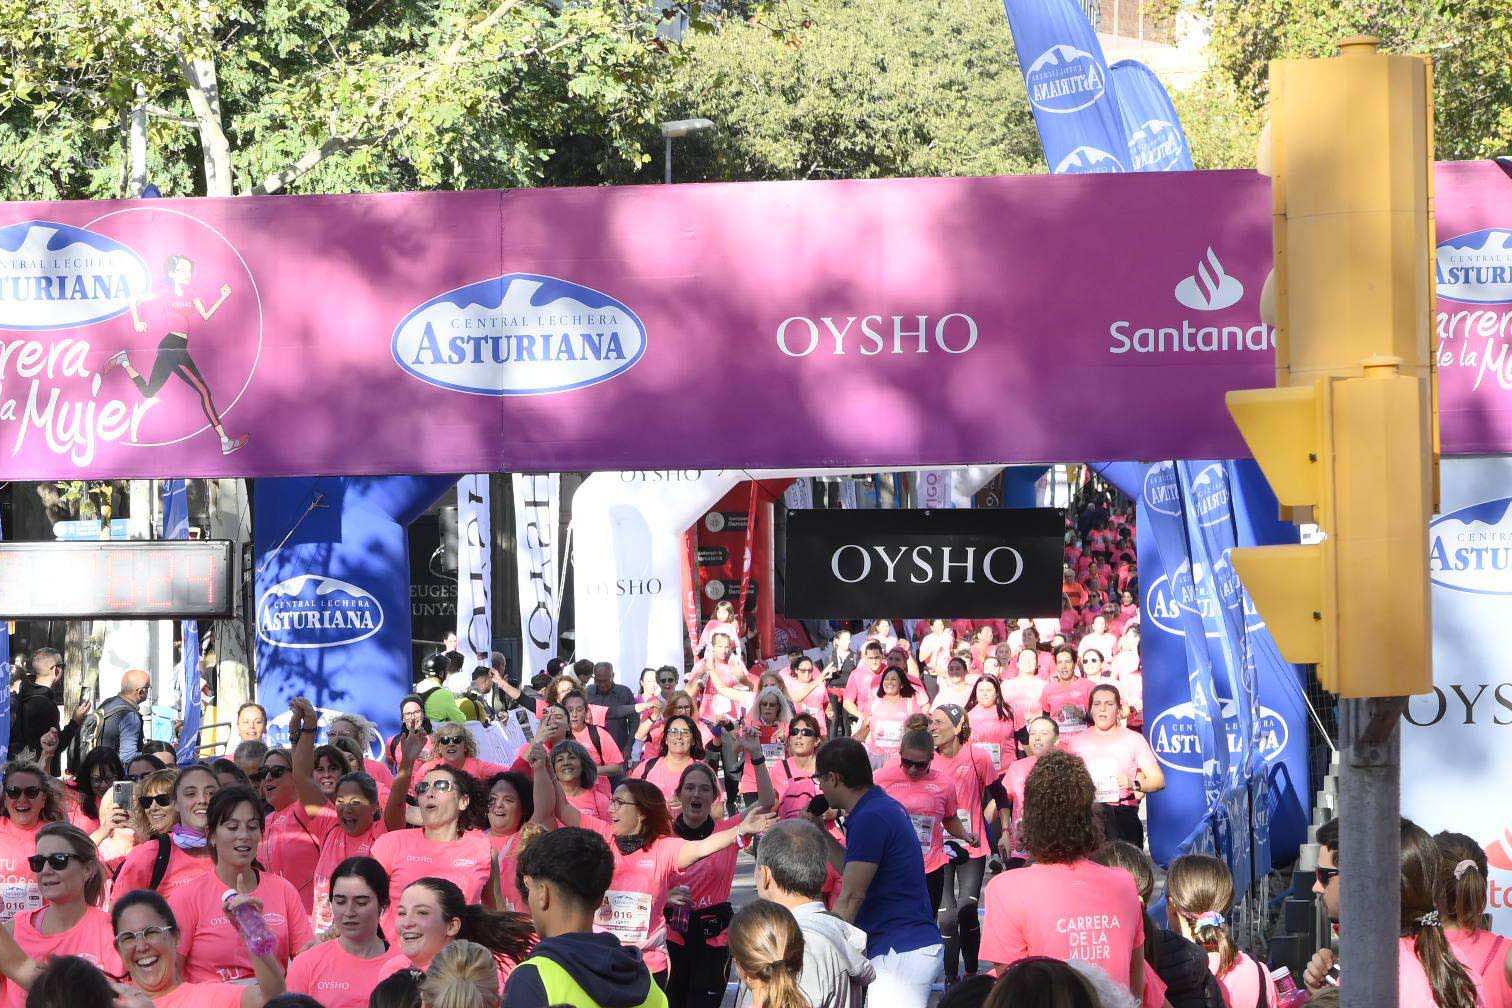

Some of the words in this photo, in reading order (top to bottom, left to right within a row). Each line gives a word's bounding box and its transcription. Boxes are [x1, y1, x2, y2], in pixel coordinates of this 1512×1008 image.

[450, 315, 530, 330] CENTRAL
[537, 313, 619, 328] LECHERA
[777, 312, 979, 357] OYSHO
[413, 321, 627, 365] ASTURIANA
[1109, 320, 1277, 354] Santand
[13, 373, 160, 468] Mujer
[831, 543, 1025, 586] OYSHO
[261, 604, 375, 632] ASTURIANA
[274, 599, 316, 610] CENTRAL
[320, 599, 371, 609] LECHERA
[5, 902, 25, 910] 016
[1056, 913, 1121, 934] CARRERA
[1069, 930, 1088, 947] DE
[1091, 930, 1109, 946] LA
